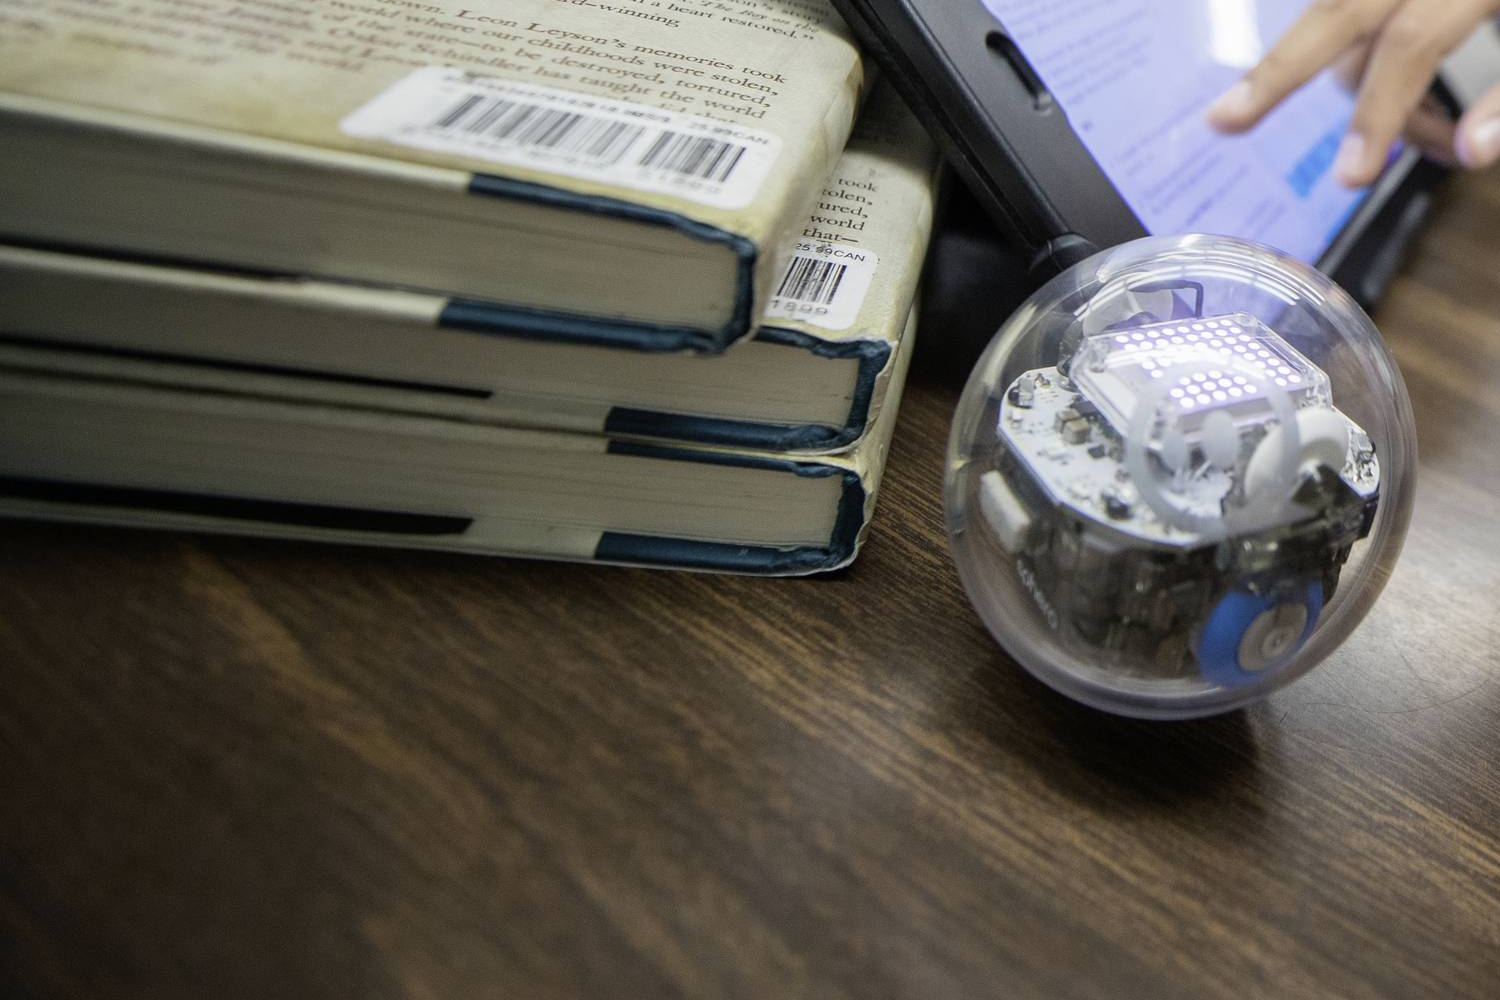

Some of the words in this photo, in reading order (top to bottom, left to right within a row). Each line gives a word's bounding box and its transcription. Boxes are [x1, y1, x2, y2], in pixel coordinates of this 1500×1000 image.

[667, 3, 712, 18] heart
[701, 0, 733, 12] The
[738, 9, 768, 21] Boy
[406, 15, 476, 33] where
[482, 30, 523, 42] our
[527, 39, 645, 65] childhoods
[654, 62, 705, 77] were
[711, 74, 778, 96] stolen,
[456, 9, 518, 27] Leon
[525, 22, 627, 48] Leyson’s
[633, 46, 734, 70] memories
[742, 67, 786, 84] took
[411, 43, 528, 72] Schindler
[533, 66, 571, 80] has
[579, 77, 652, 95] taught
[660, 91, 695, 103] the
[704, 100, 766, 119] world
[514, 48, 542, 60] be
[551, 56, 665, 84] destroyed,
[676, 80, 771, 108] tortured,
[838, 178, 879, 193] took
[810, 215, 865, 231] world
